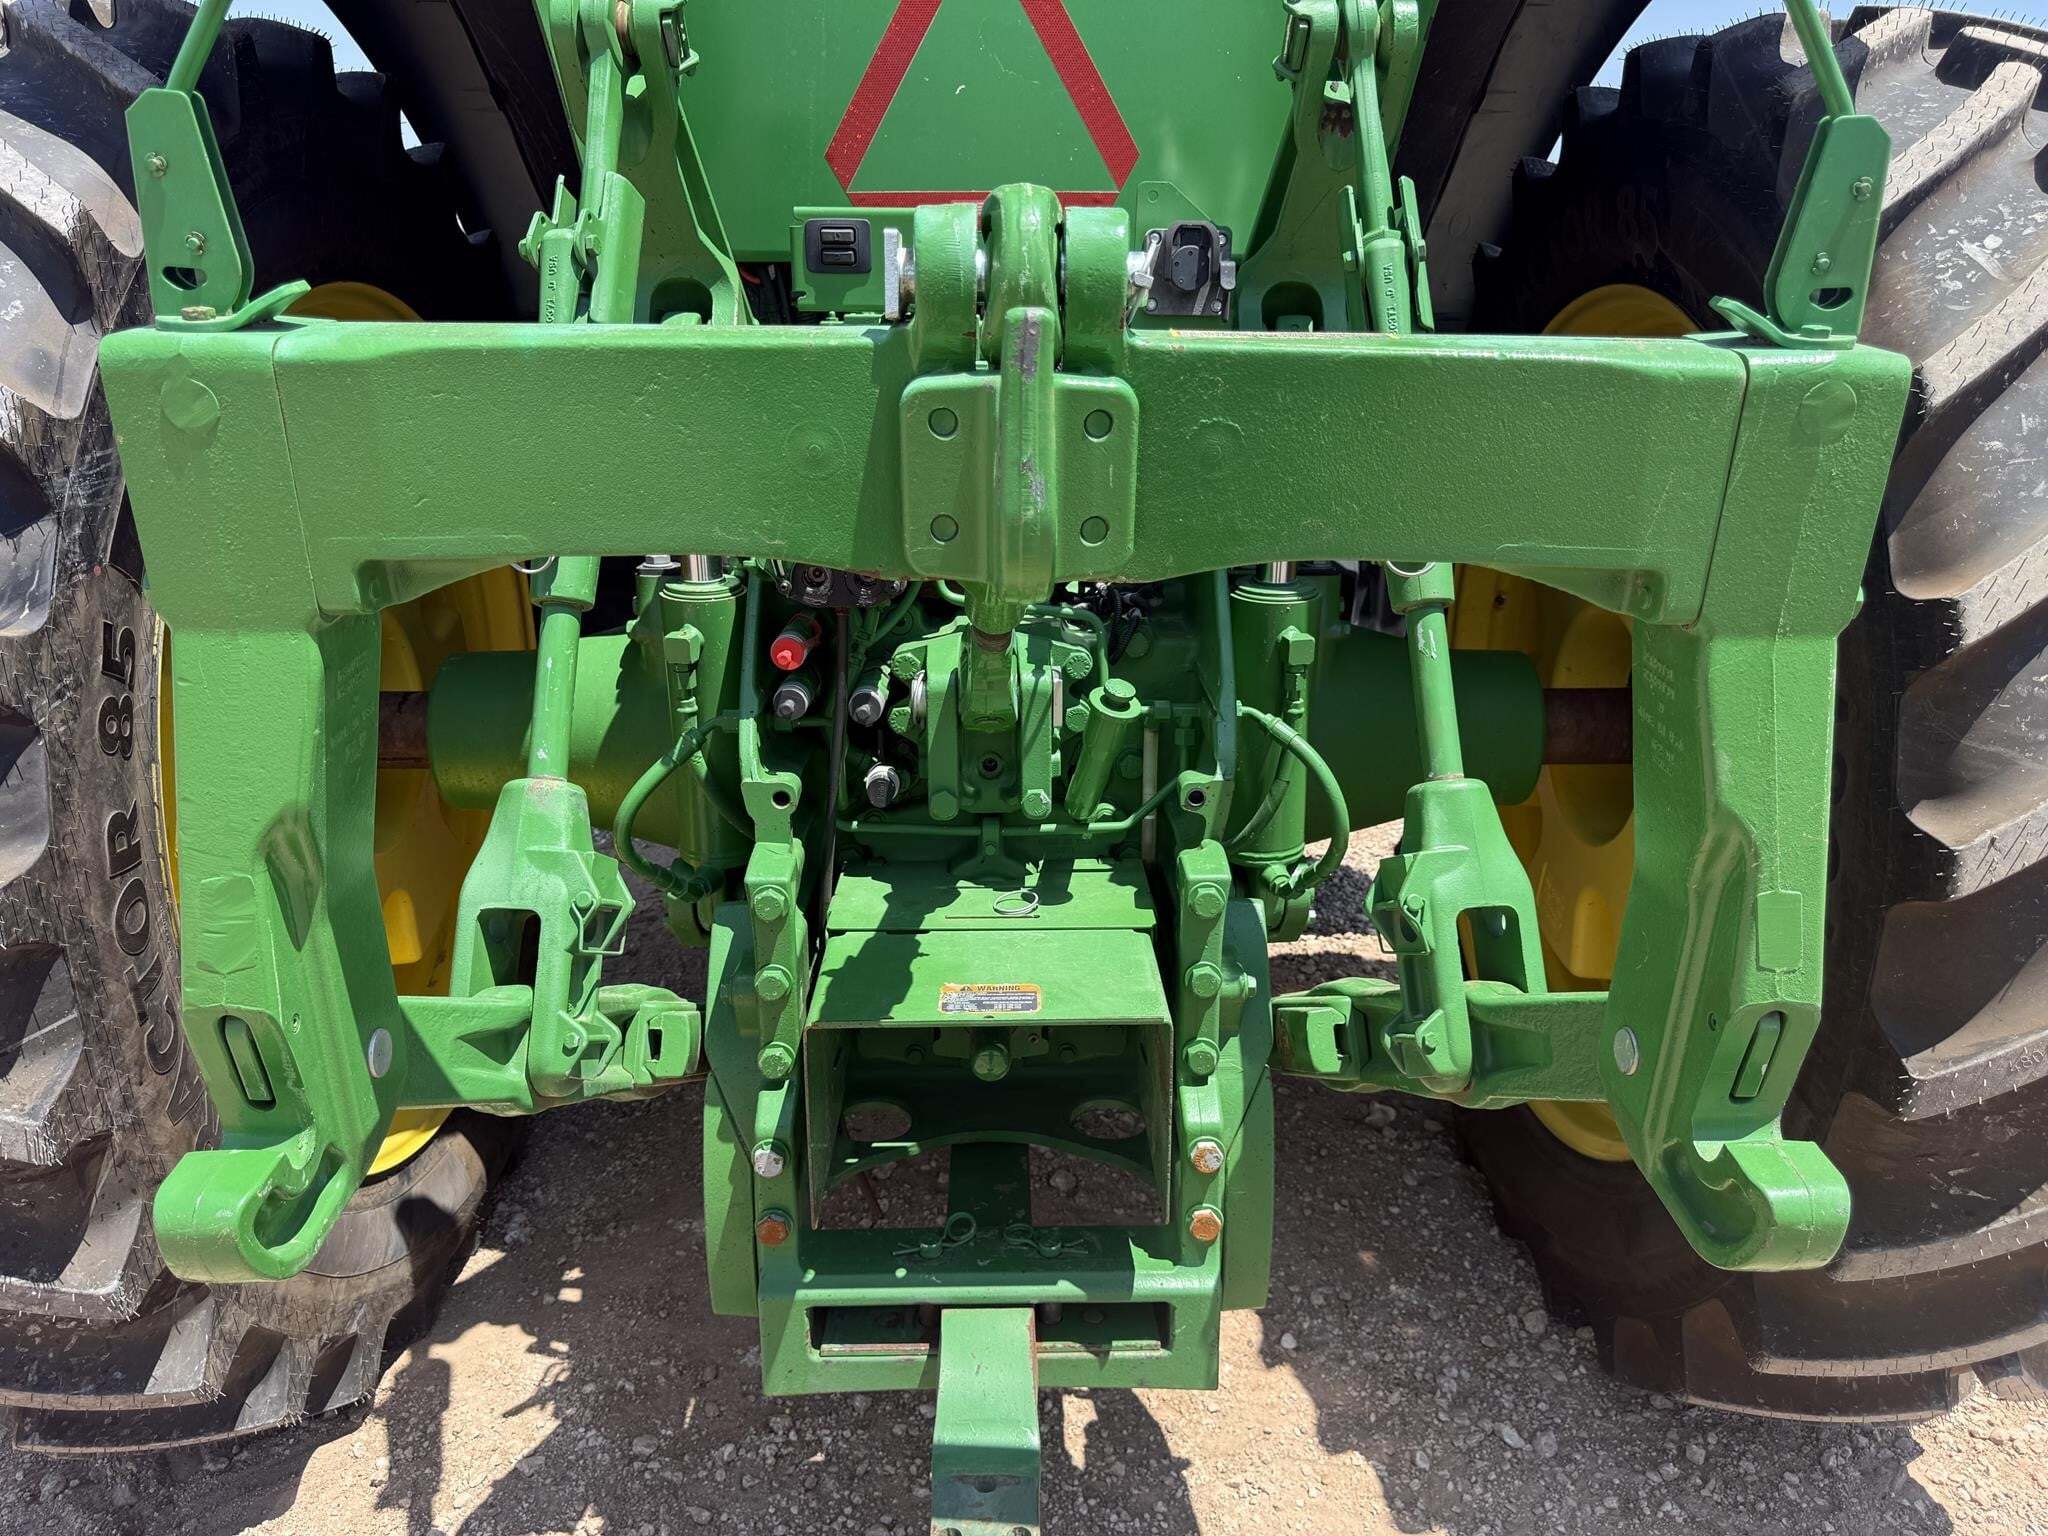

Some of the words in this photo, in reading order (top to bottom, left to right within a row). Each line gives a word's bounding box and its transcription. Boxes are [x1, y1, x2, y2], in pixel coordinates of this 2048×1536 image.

[548, 254, 558, 277] USA
[1382, 262, 1394, 285] USA
[96, 618, 135, 761] 85
